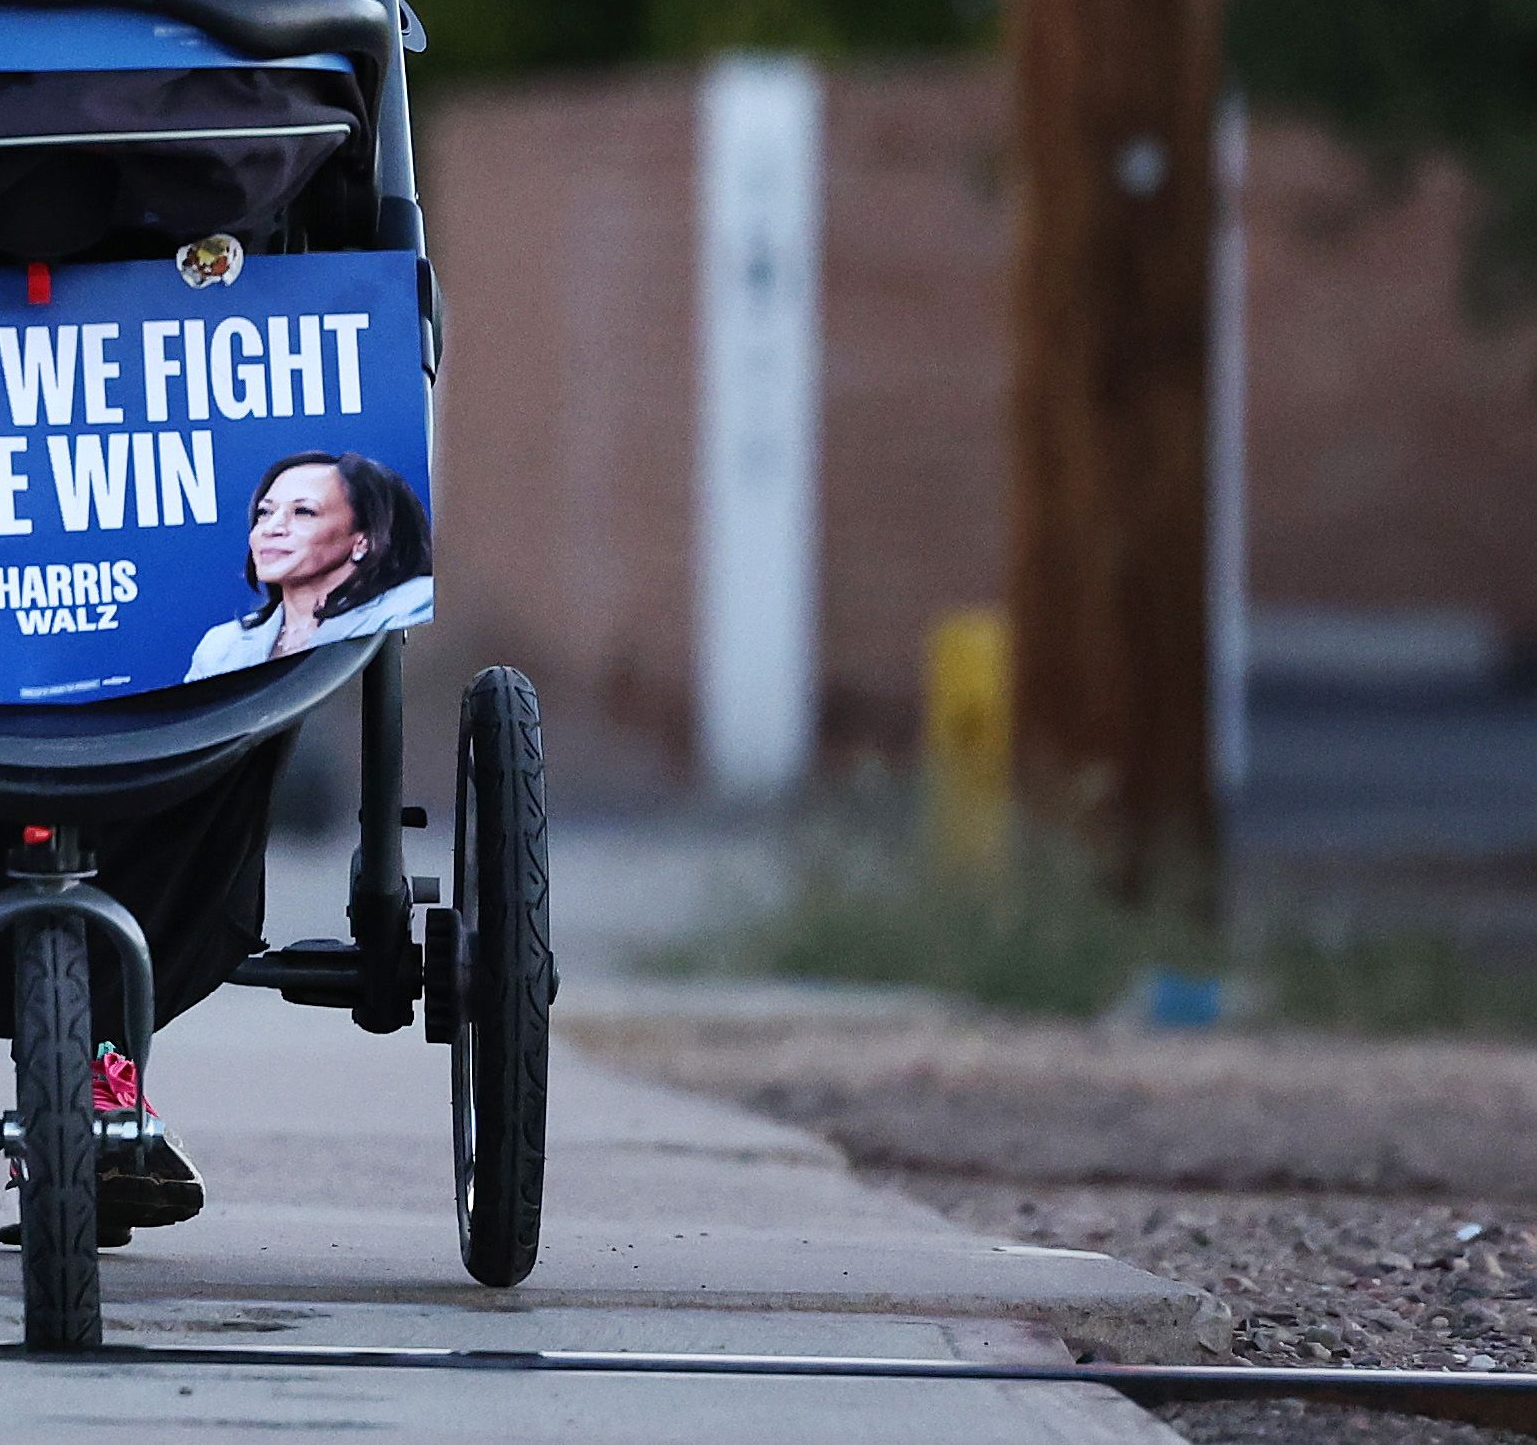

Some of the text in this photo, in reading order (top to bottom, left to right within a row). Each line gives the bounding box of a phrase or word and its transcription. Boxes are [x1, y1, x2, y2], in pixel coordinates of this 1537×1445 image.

[142, 312, 370, 423] FIGHT
[46, 429, 219, 531] WIN
[16, 604, 120, 636] WALZ
